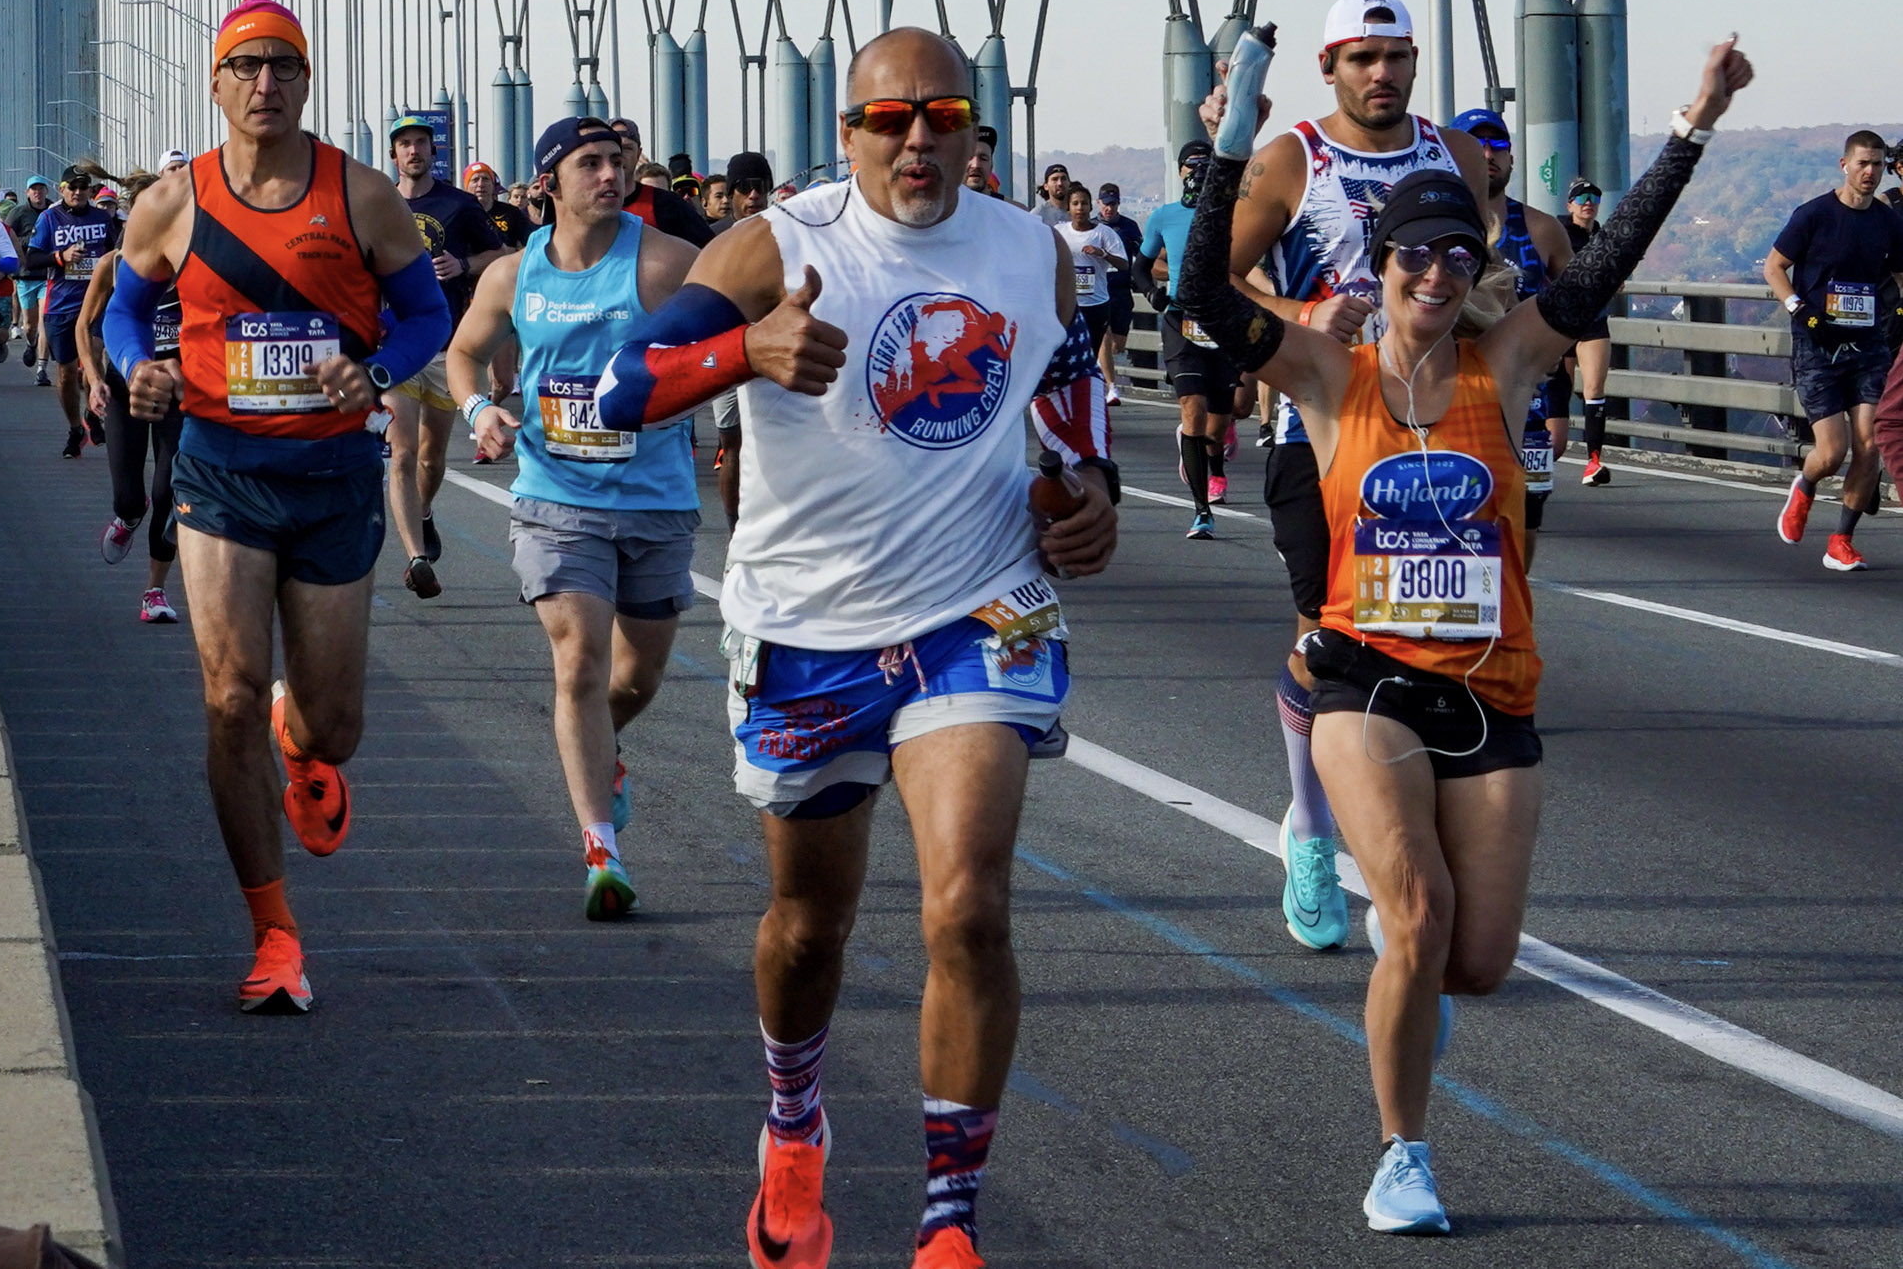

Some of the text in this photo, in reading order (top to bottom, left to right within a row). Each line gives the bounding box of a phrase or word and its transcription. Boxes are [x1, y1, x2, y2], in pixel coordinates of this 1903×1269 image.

[285, 231, 328, 250] CENTRAL
[1843, 296, 1865, 311] 11979
[241, 319, 268, 338] tcs
[308, 329, 326, 337] TATA
[262, 344, 314, 376] 13319
[549, 378, 572, 395] tcs
[908, 358, 1004, 440] RUNNING CREW
[569, 401, 600, 430] 842
[1372, 474, 1484, 513] Hyland's
[1375, 527, 1410, 550] tcs
[1400, 559, 1466, 599] 9800
